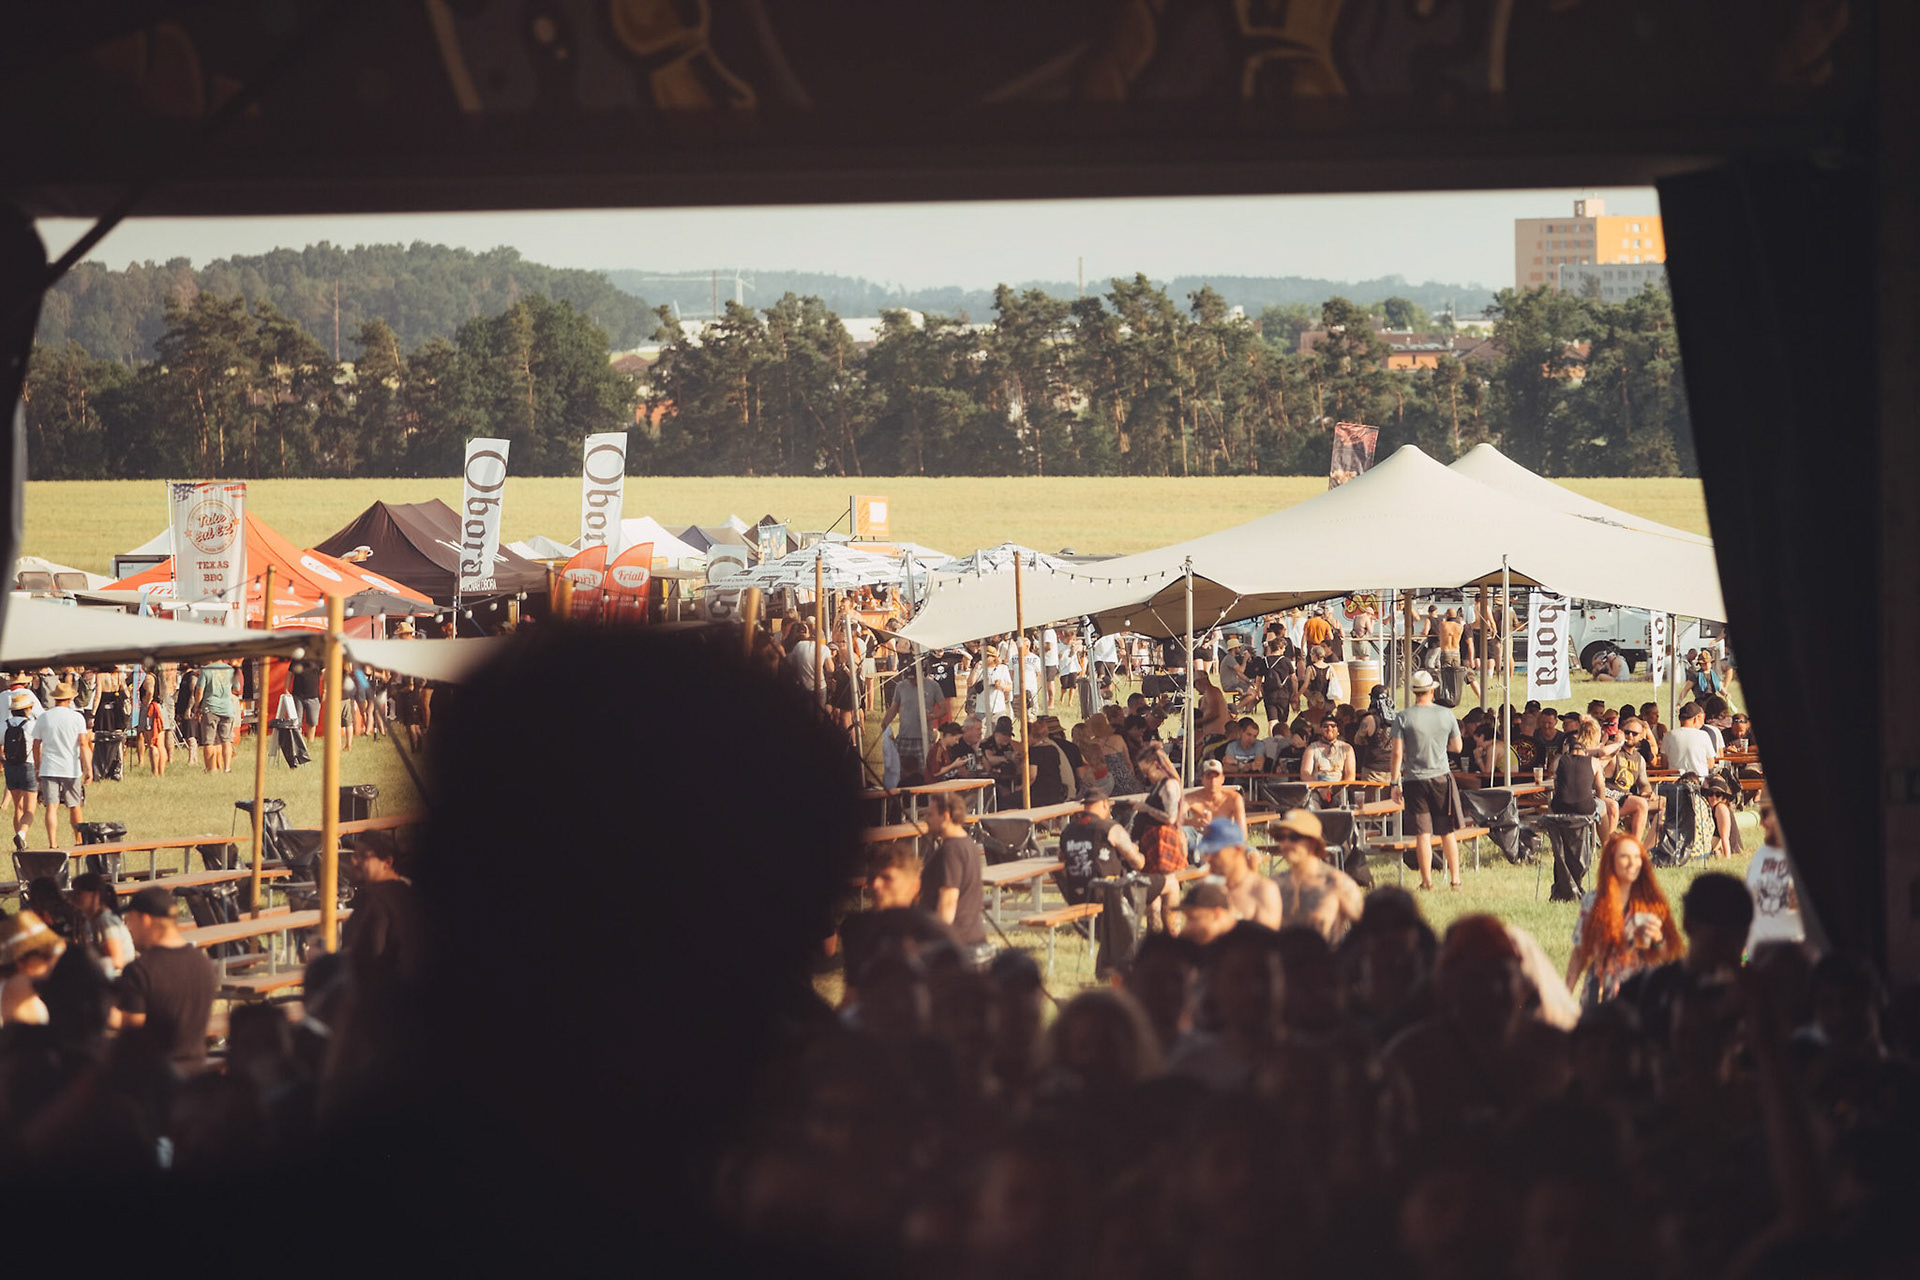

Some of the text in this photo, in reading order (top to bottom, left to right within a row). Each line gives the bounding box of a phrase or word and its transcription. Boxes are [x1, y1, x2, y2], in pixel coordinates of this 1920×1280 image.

[461, 450, 507, 578] Obora
[584, 444, 625, 546] Obor
[196, 561, 230, 570] TEXAS
[203, 573, 223, 582] BBQ
